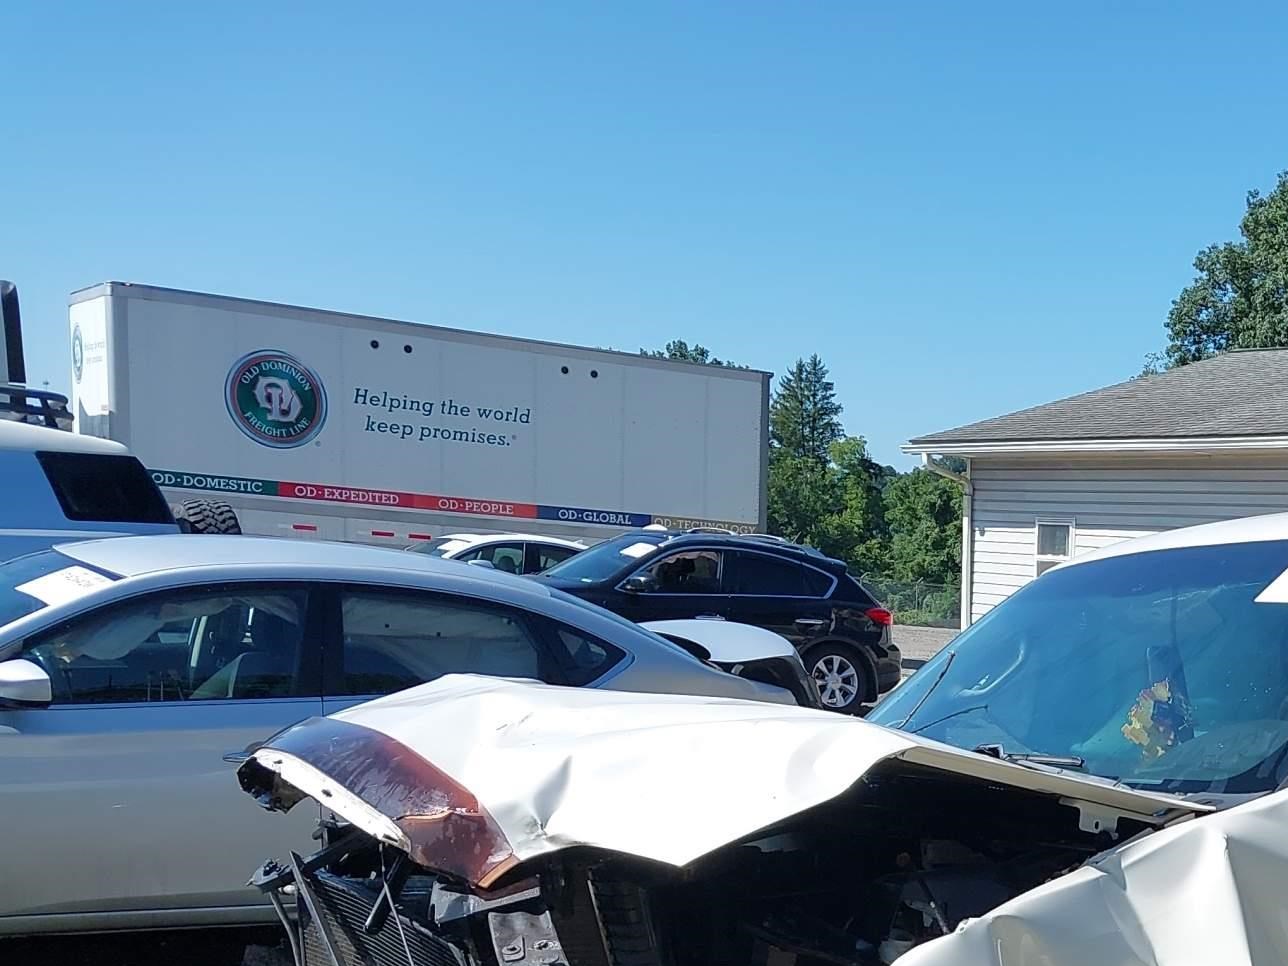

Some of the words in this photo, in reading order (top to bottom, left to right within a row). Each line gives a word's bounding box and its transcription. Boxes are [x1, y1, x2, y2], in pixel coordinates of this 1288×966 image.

[241, 365, 260, 384] OLD
[261, 361, 312, 392] DOMINION
[353, 388, 434, 416] Helping
[440, 400, 471, 417] the
[476, 407, 531, 424] world
[244, 411, 288, 437] FREIGHT
[290, 417, 311, 436] LINE
[364, 415, 414, 439] keep
[418, 426, 511, 446] promises.
